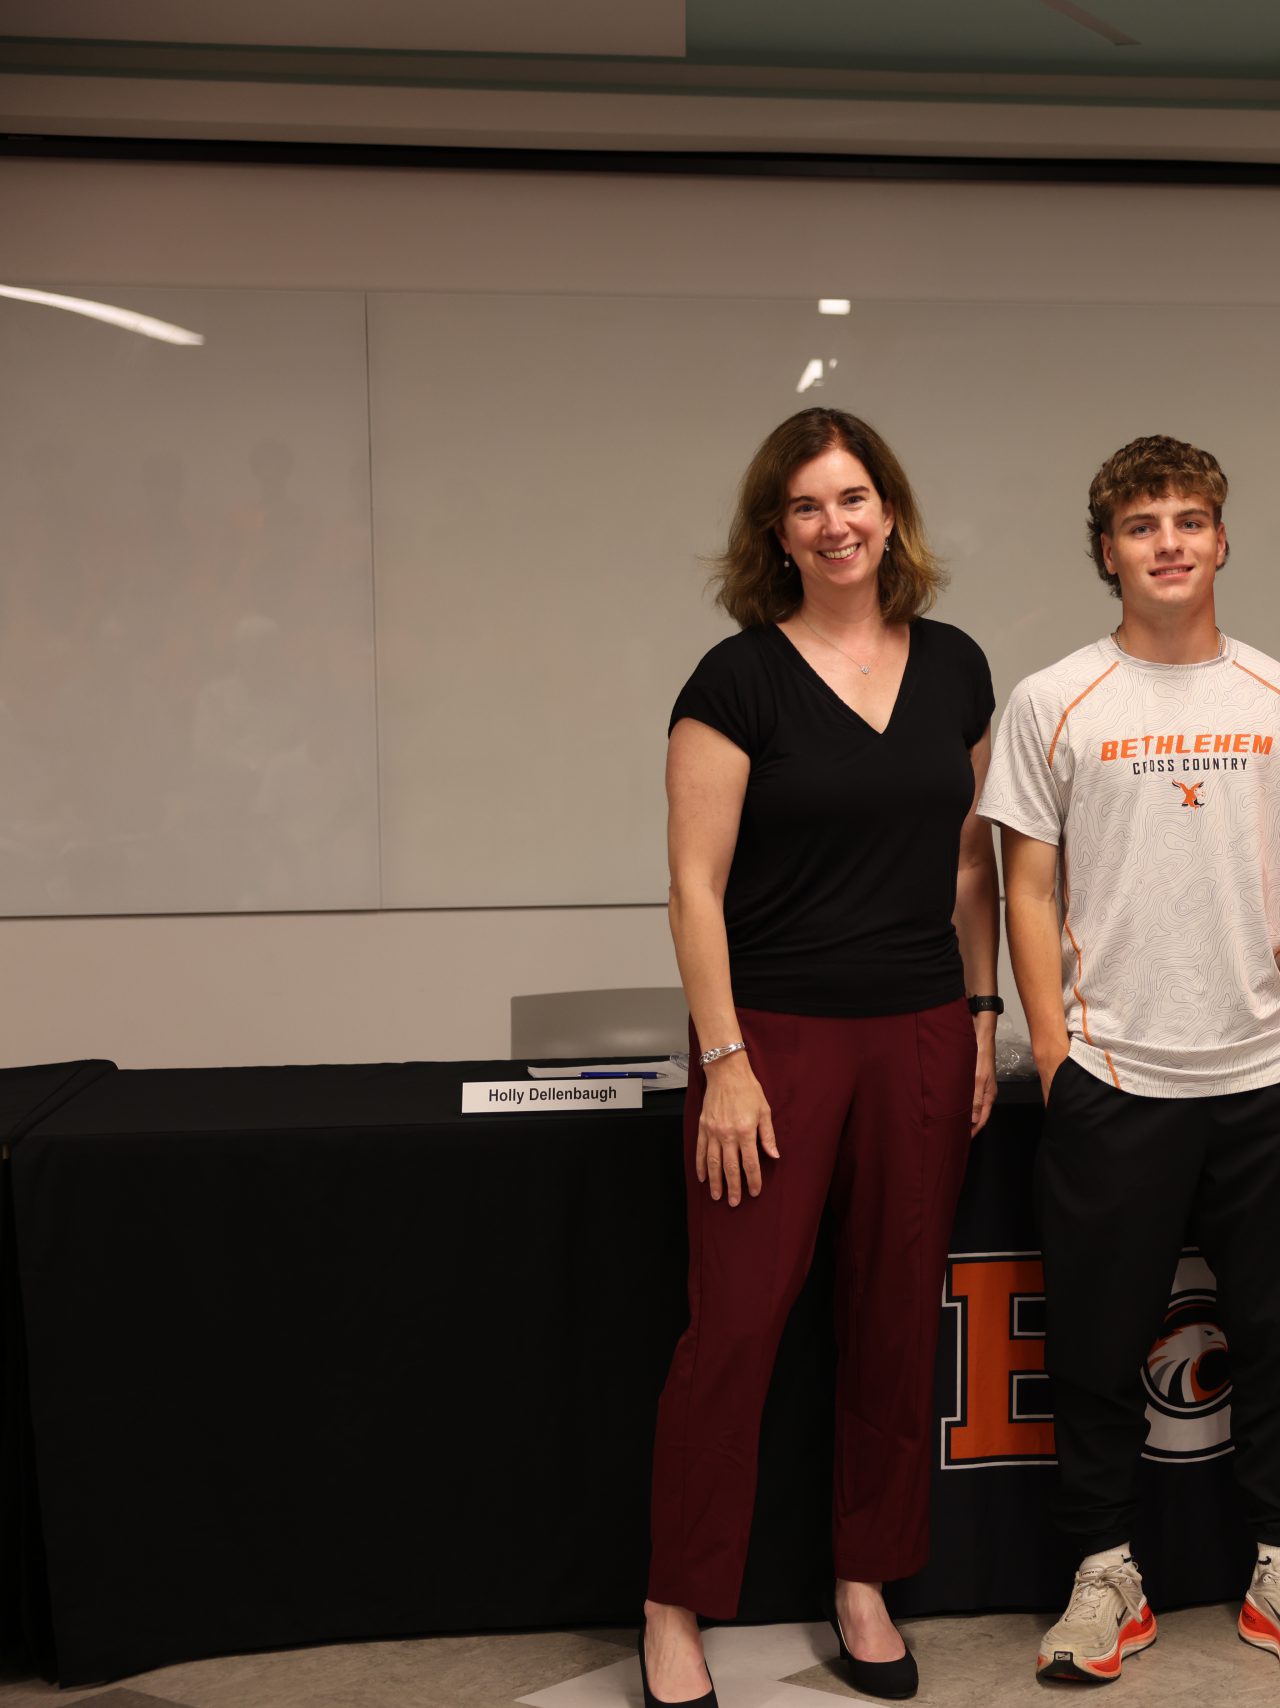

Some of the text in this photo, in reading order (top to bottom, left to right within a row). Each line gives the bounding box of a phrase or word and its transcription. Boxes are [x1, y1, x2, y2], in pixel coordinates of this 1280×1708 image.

[1100, 733, 1275, 762] BETHLEHEM
[1182, 757, 1248, 772] COUNTRY
[488, 1086, 617, 1105] Holly Dellenbaugh
